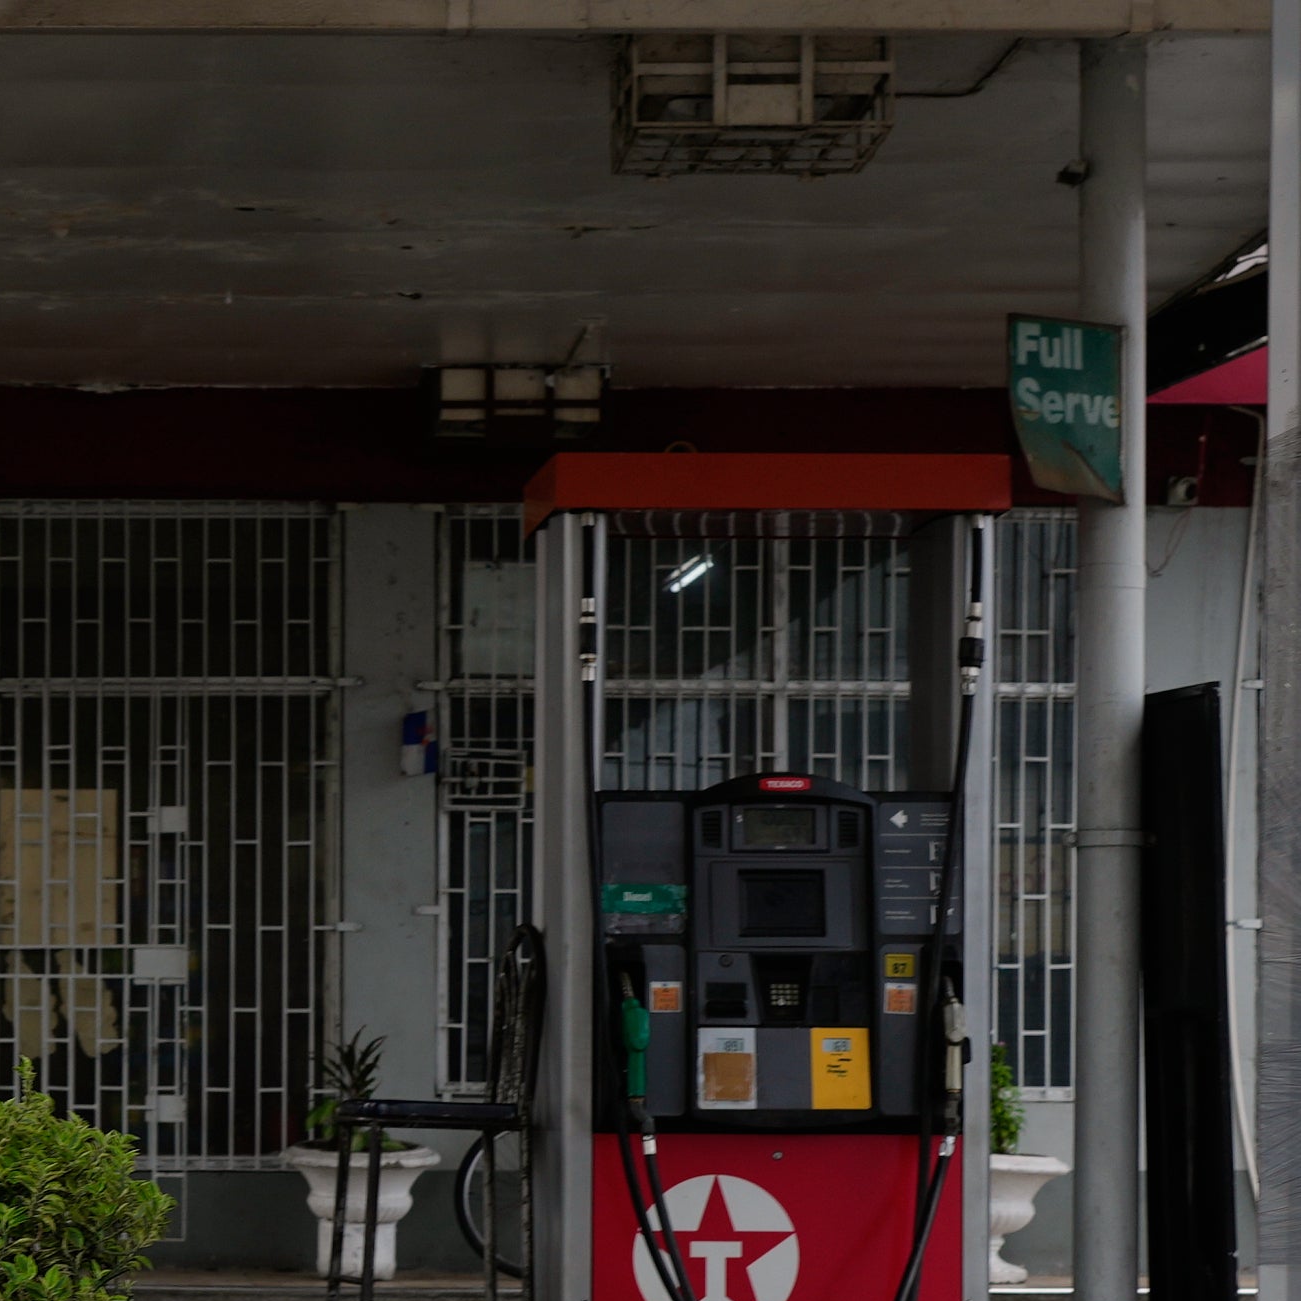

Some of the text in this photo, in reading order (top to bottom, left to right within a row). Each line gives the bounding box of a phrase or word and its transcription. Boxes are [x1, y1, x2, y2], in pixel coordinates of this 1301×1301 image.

[1015, 323, 1084, 371] Full
[1016, 377, 1120, 429] Serve
[891, 962, 908, 975] 87
